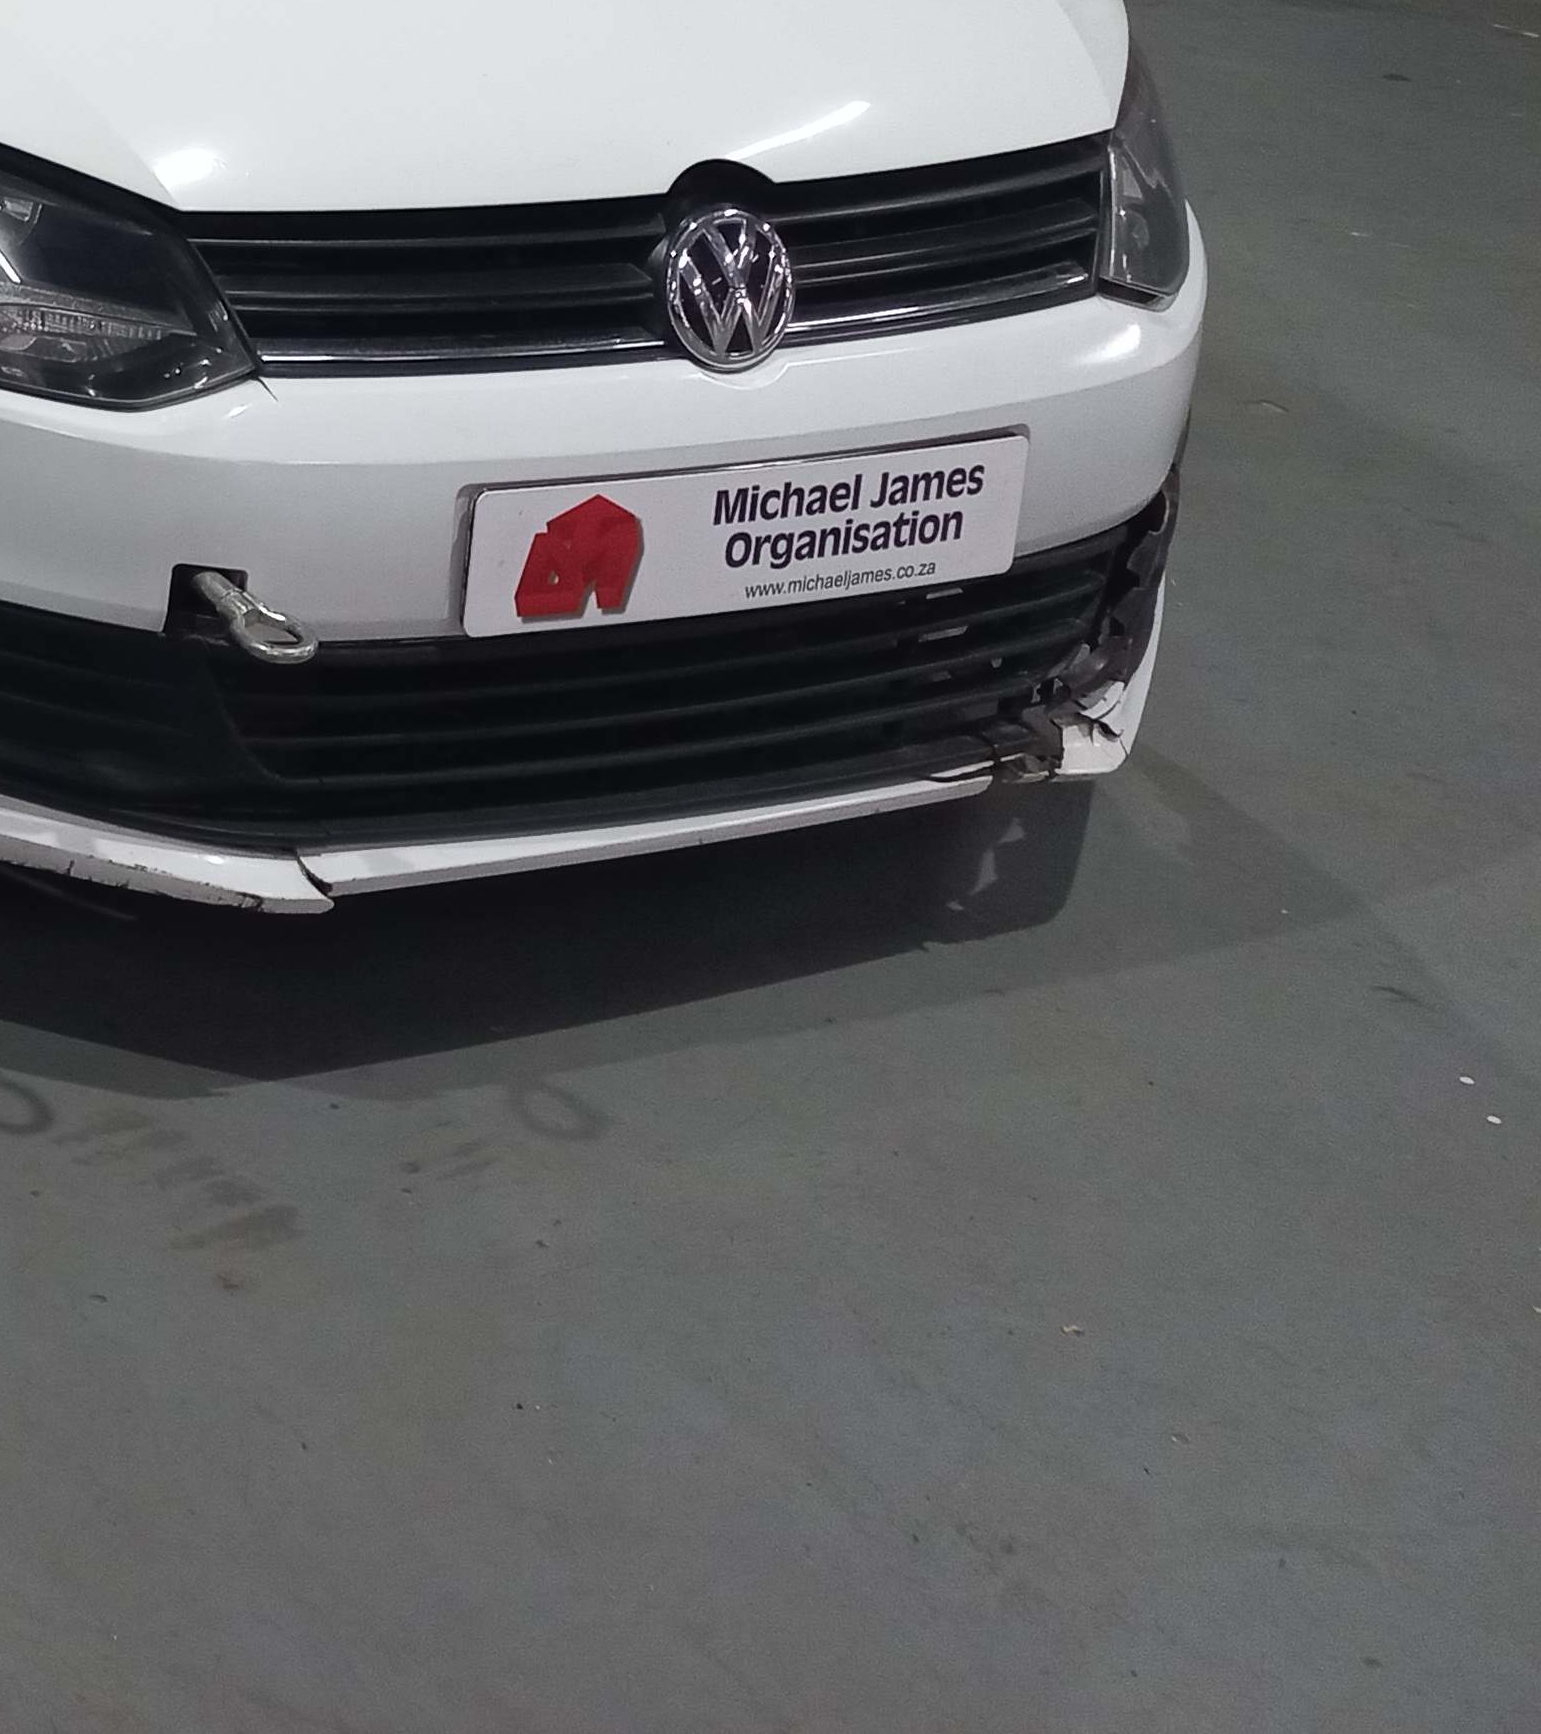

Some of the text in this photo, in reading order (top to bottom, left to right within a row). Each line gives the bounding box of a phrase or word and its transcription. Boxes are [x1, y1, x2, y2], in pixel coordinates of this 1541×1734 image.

[713, 463, 985, 526] Michael James
[724, 509, 963, 569] Organisation
[745, 561, 936, 599] www.michaeljames.co.za
